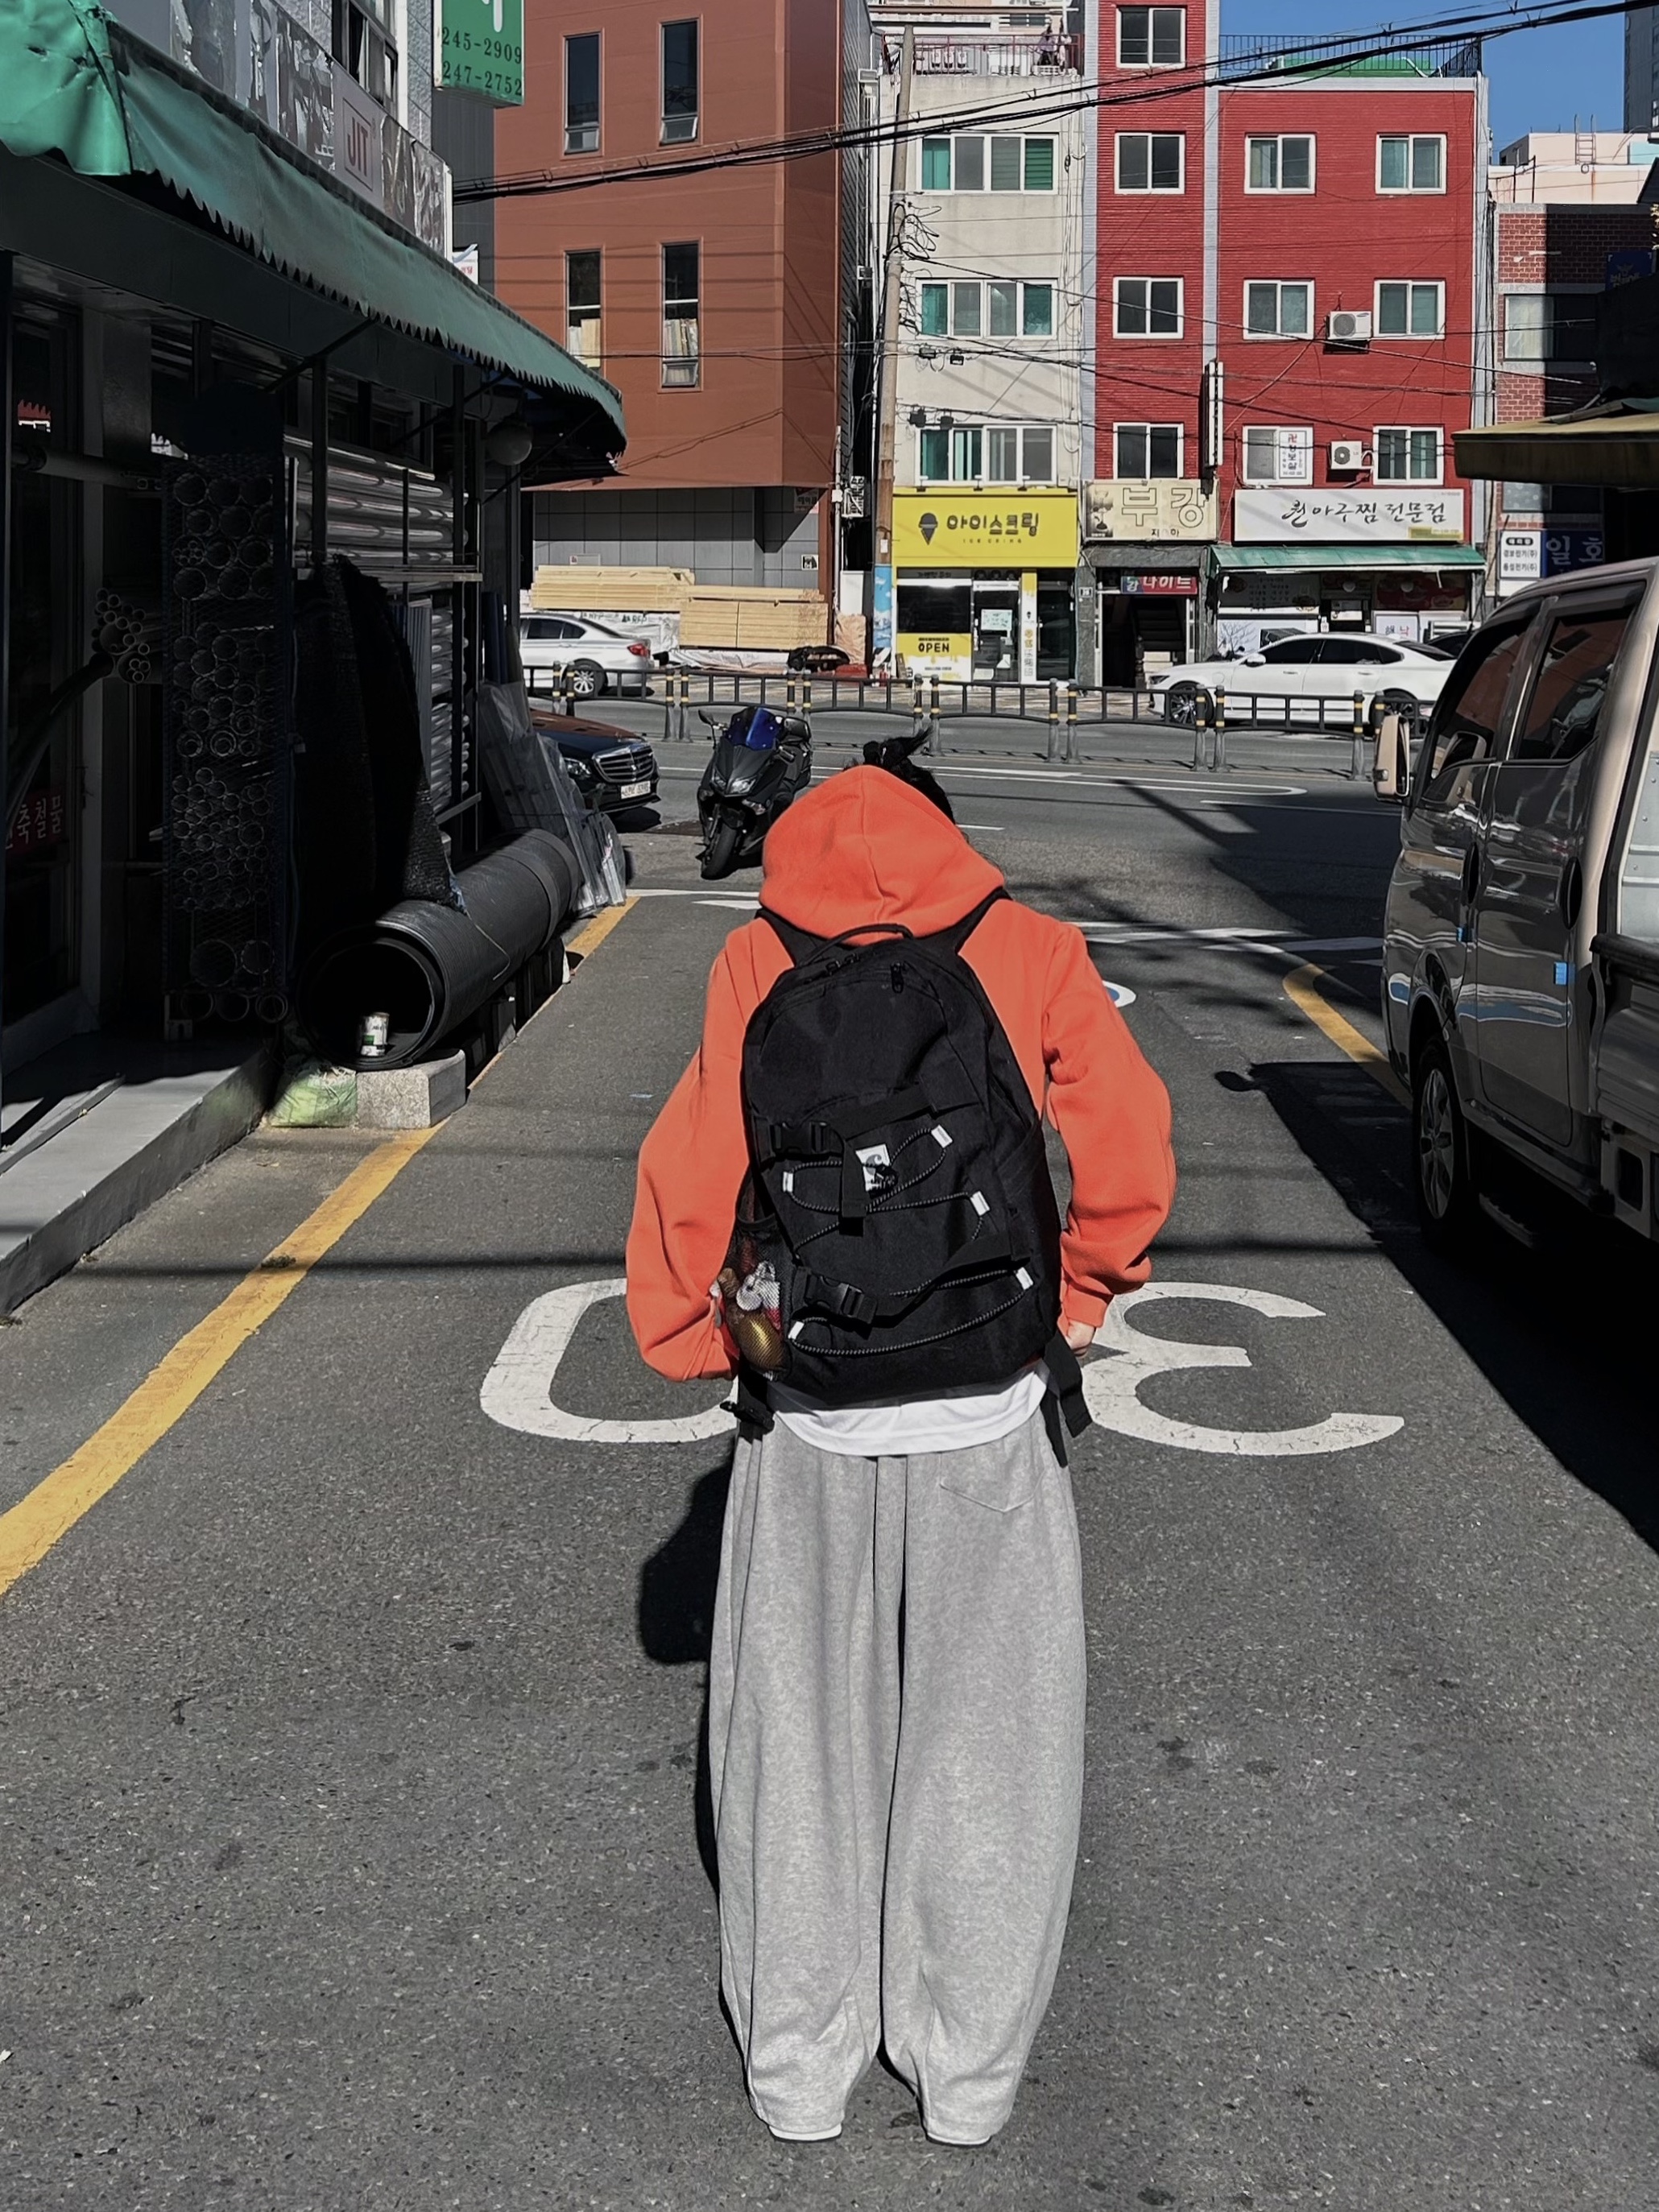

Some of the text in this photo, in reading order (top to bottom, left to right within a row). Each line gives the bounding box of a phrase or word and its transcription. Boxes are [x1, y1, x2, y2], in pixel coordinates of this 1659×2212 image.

[442, 27, 522, 64] 245-2909
[443, 60, 523, 96] 247-2752
[347, 116, 368, 177] JIT
[946, 512, 1039, 536] 아이스크링
[1121, 487, 1208, 528] 부강
[1384, 502, 1446, 523] 전문점
[918, 643, 950, 653] OPEN
